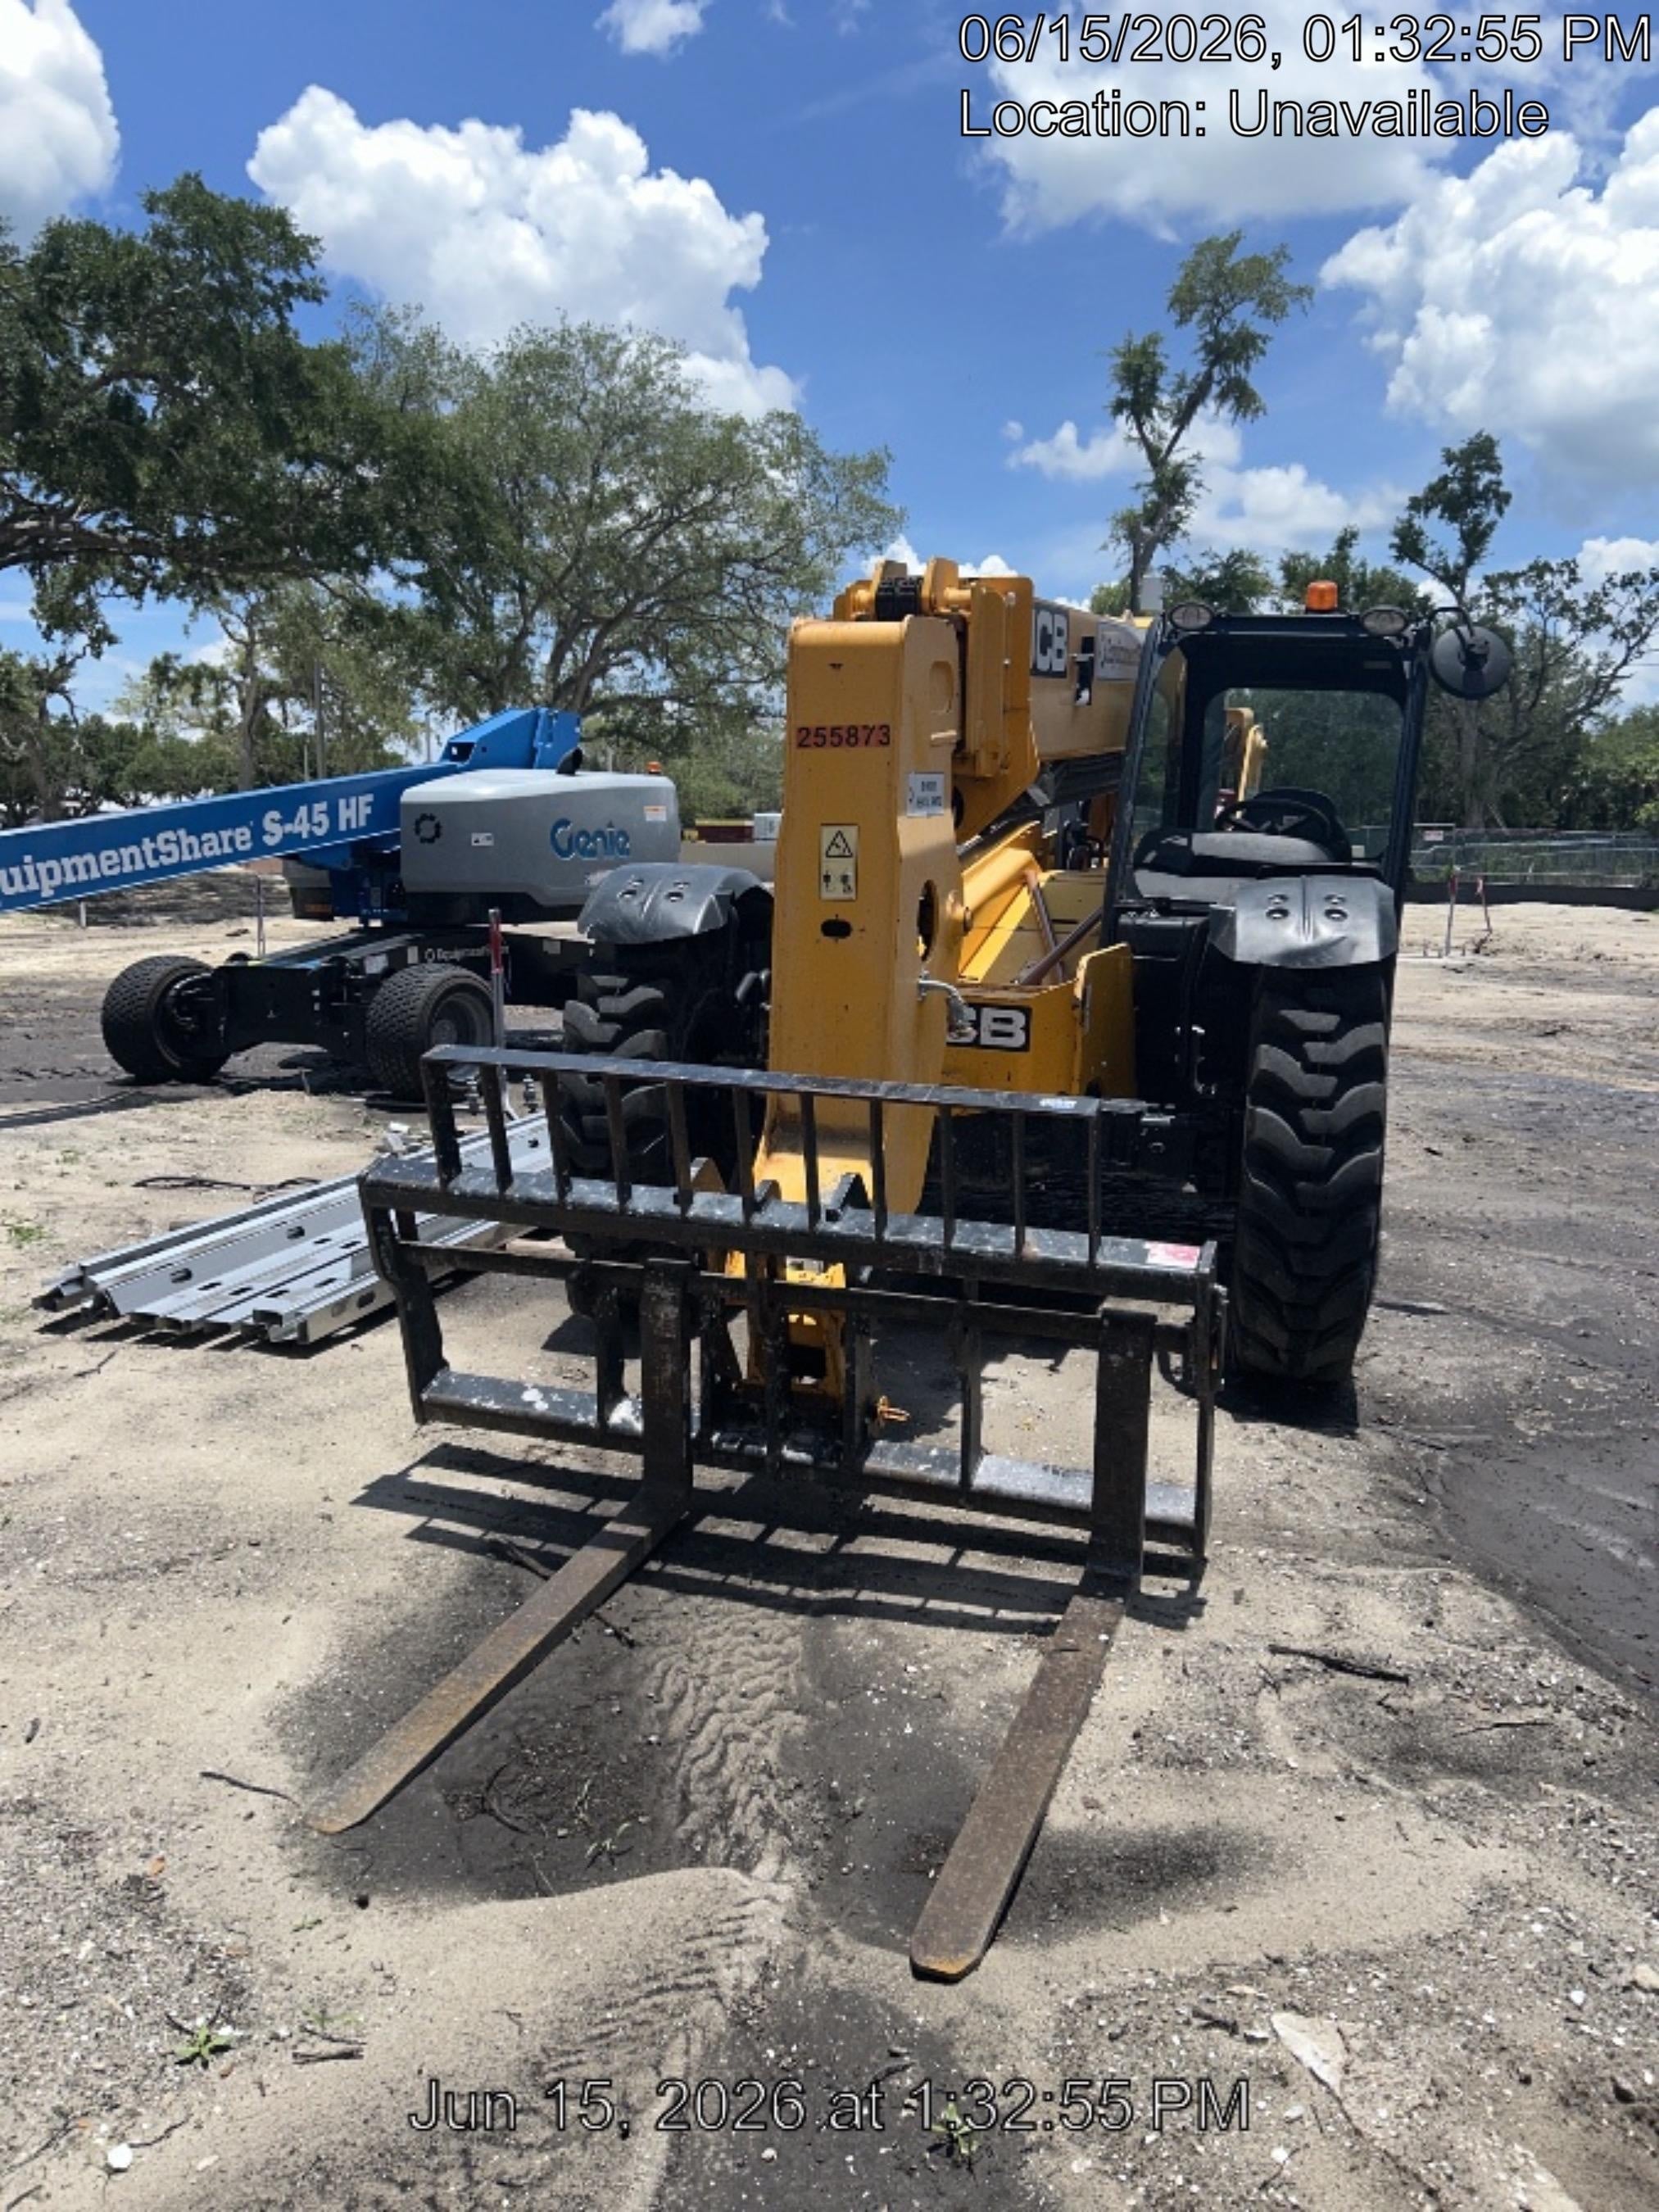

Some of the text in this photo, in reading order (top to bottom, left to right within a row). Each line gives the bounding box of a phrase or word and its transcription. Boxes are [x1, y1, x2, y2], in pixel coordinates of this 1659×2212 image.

[1031, 610, 1067, 671] CB
[797, 724, 891, 748] 255873
[262, 801, 329, 847] S-45
[338, 793, 374, 832] HF
[550, 818, 630, 860] Genie
